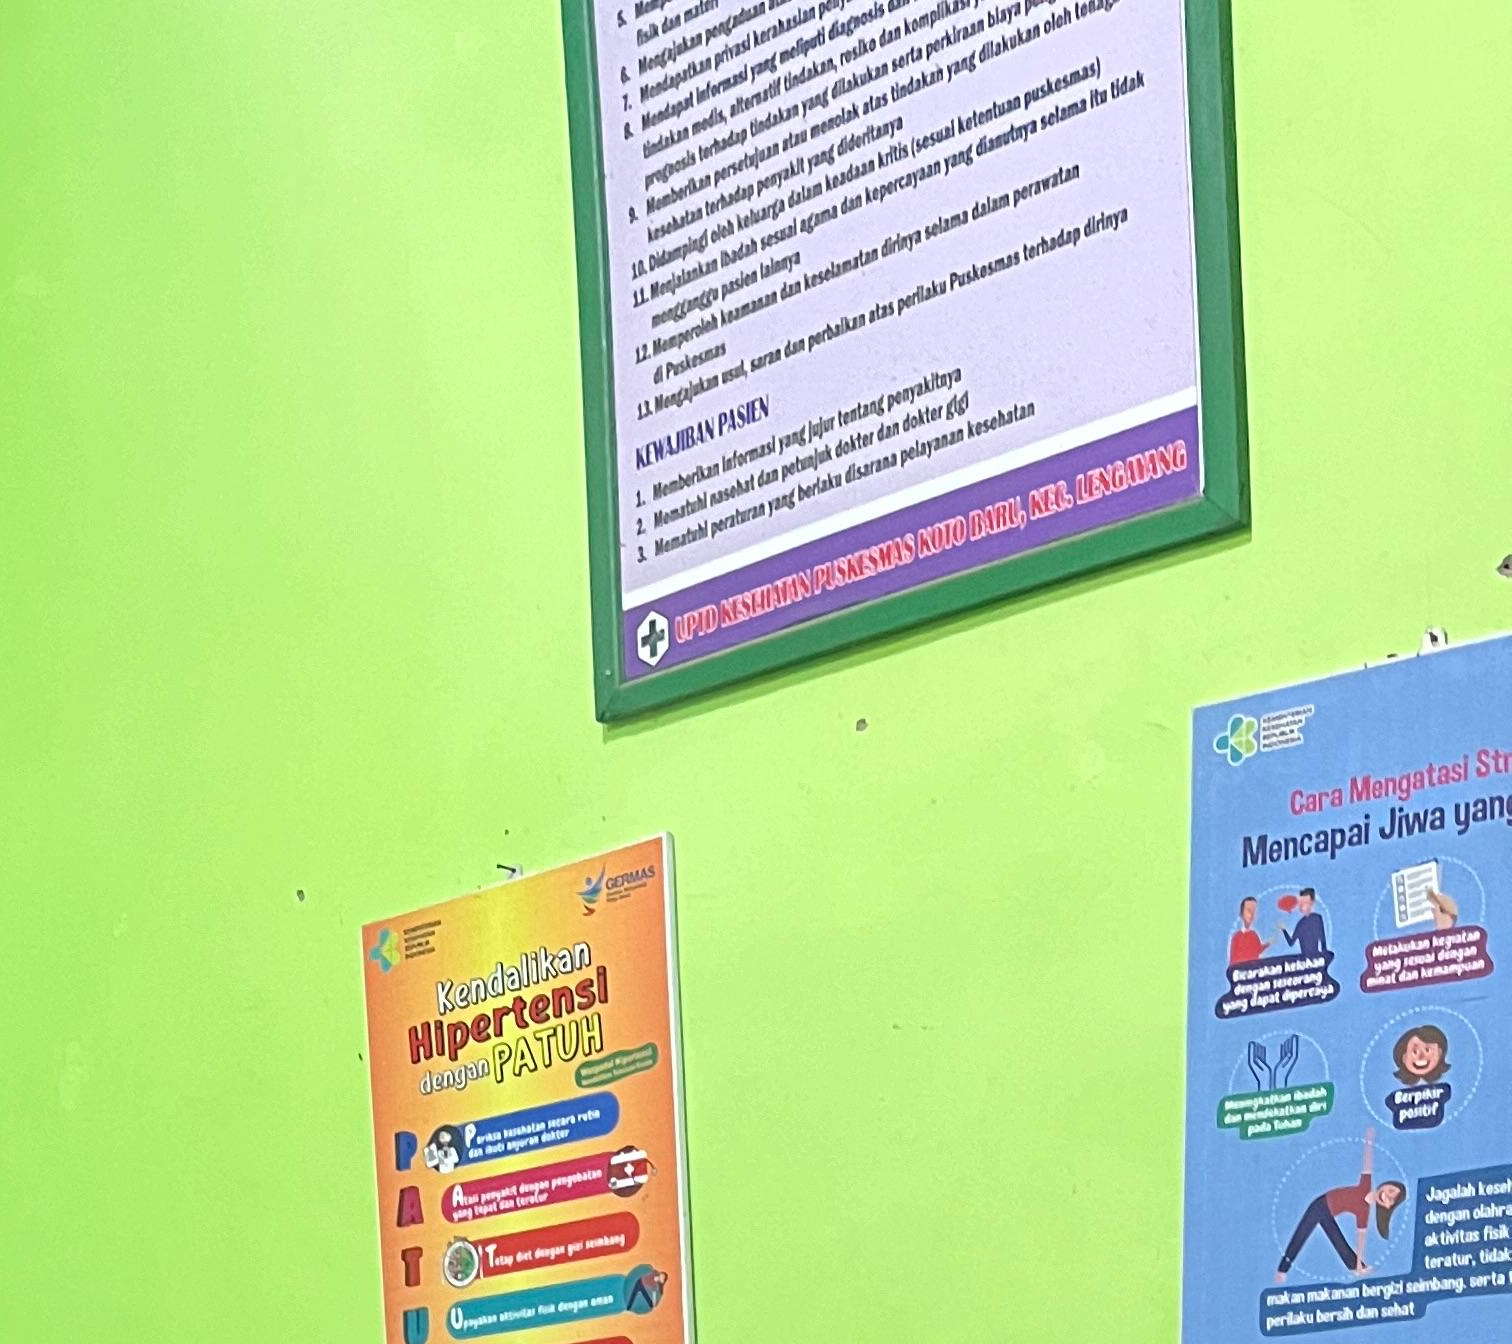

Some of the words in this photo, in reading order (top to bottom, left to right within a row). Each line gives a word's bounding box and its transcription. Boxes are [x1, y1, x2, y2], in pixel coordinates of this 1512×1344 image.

[636, 419, 713, 469] KEWAJIBAN
[718, 395, 768, 436] PASIEN
[1290, 788, 1345, 815] Cara
[1348, 754, 1469, 802] Mengatasi
[1243, 813, 1369, 867] Mencapai
[1379, 806, 1444, 839] Jiwa
[605, 865, 656, 891] GERMAS
[436, 941, 591, 1015] Kendalikan
[408, 966, 609, 1064] Hipertensi
[420, 1055, 490, 1095] dengan
[492, 1012, 604, 1083] PATUH
[1426, 1182, 1475, 1204] Jagalah
[1425, 1209, 1469, 1226] dengan
[1425, 1229, 1479, 1246] aktivitas
[1484, 1224, 1509, 1240] fisik
[1267, 1291, 1304, 1305] makan
[1307, 1284, 1359, 1302] makanan
[1362, 1280, 1402, 1299] bergizi
[1470, 1271, 1504, 1287] serta
[1266, 1311, 1313, 1330] perilaku
[1316, 1307, 1353, 1322] bersih
[1356, 1305, 1378, 1318] dan
[1381, 1302, 1414, 1317] sehat
